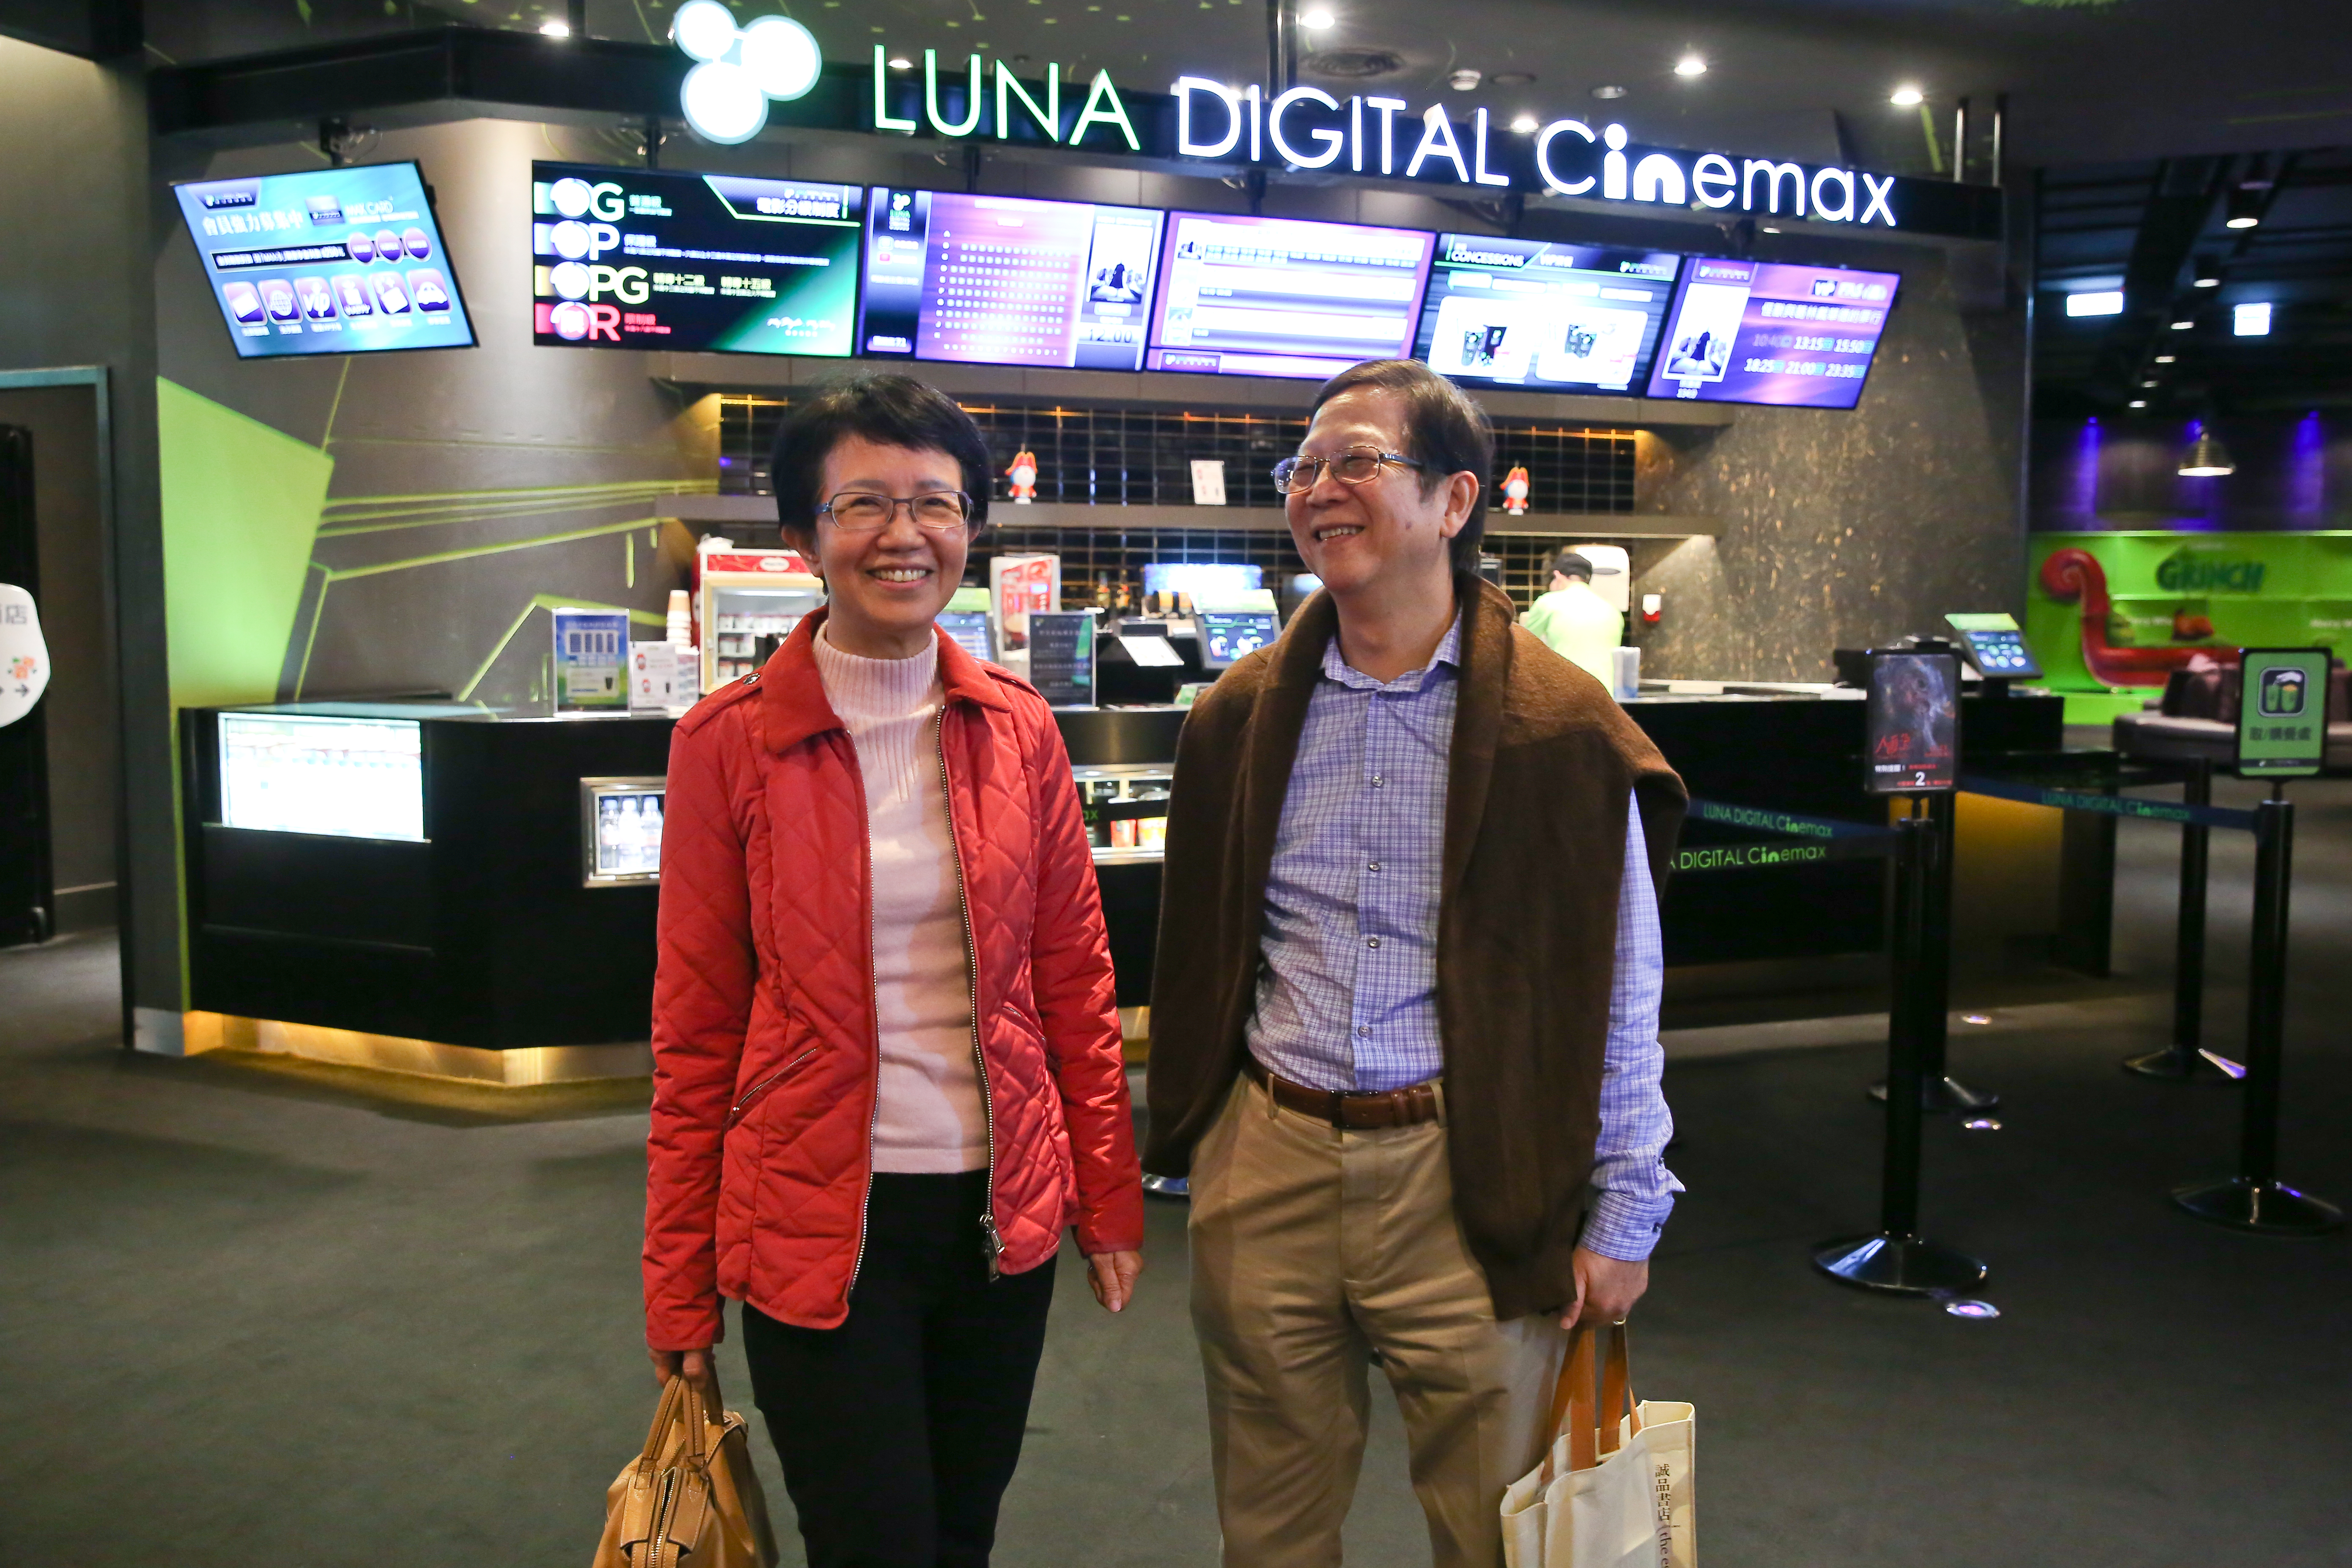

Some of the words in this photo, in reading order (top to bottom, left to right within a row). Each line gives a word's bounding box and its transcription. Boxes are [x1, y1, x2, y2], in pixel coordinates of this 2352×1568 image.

[874, 44, 1140, 151] LUNA
[1177, 74, 1510, 187] DIGITAL
[1536, 119, 1897, 227] Cinemax
[590, 182, 625, 222] G
[588, 223, 620, 261] P
[1451, 250, 1525, 268] CONCESSIONS
[588, 264, 650, 304] PG
[588, 303, 622, 341] R
[0, 603, 27, 625] 店
[1915, 771, 1926, 786] 2
[1734, 808, 1775, 829] DIGITAL
[1776, 816, 1833, 838] Cinemax
[1680, 849, 1744, 869] DIGITAL
[1748, 846, 1827, 864] Cinemax
[1655, 1464, 1671, 1521] 誠品書店
